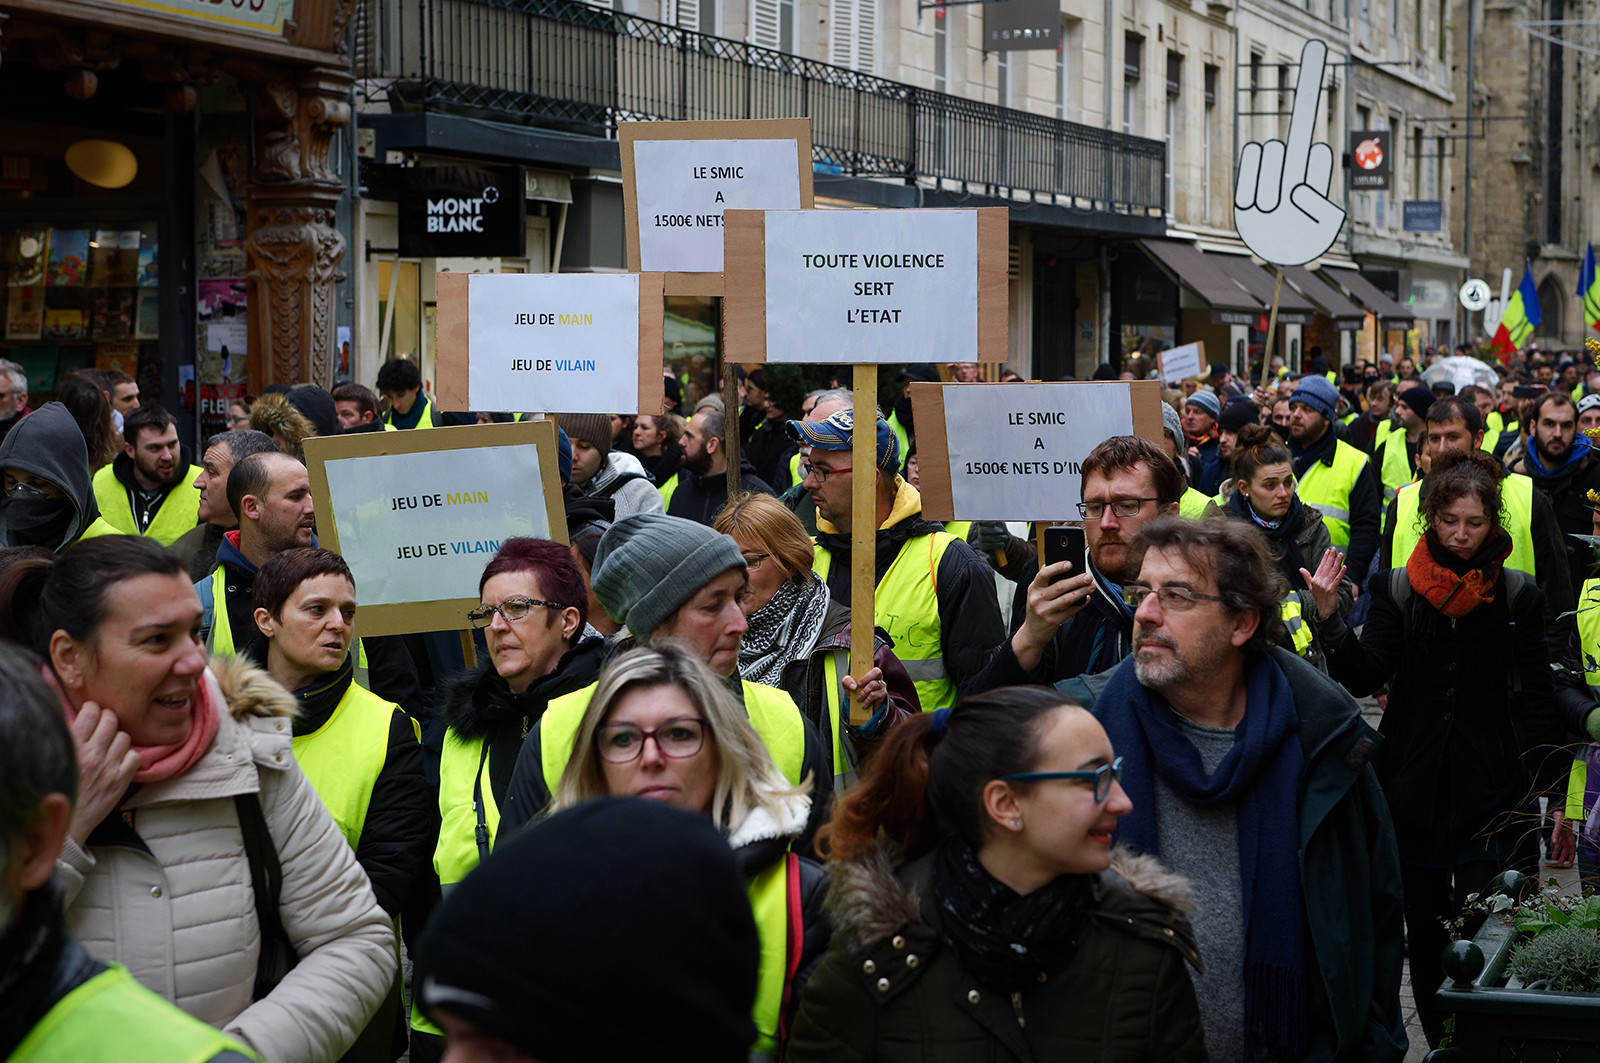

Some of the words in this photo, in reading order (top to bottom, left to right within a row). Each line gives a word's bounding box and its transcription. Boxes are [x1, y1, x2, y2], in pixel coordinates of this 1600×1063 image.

[992, 28, 1051, 40] ESPRIT
[693, 166, 708, 179] LE
[710, 166, 744, 180] SMIC
[714, 190, 725, 204] A
[427, 198, 484, 215] MONT
[427, 216, 484, 233] BLANC
[654, 214, 693, 228] 1500€
[802, 254, 859, 269] TOUTE
[862, 253, 945, 269] VIOLENCE
[853, 281, 895, 296] SERT
[514, 313, 536, 326] JEU
[539, 313, 555, 326] DE
[558, 313, 593, 326] MAIN
[847, 308, 902, 324] L'ETAT
[511, 359, 532, 371] JEU
[536, 359, 552, 371] DE
[554, 359, 596, 372] VILAIN
[1008, 412, 1025, 426] LE
[1027, 412, 1066, 425] SMIC
[1033, 437, 1046, 450] A
[965, 461, 1009, 475] 1500€
[1012, 461, 1050, 475] NETS
[391, 496, 418, 511] JEU
[421, 493, 443, 508] DE
[446, 490, 489, 506] MAIN
[396, 545, 423, 560] JEU
[426, 543, 448, 557] DE
[449, 539, 500, 555] VILAIN
